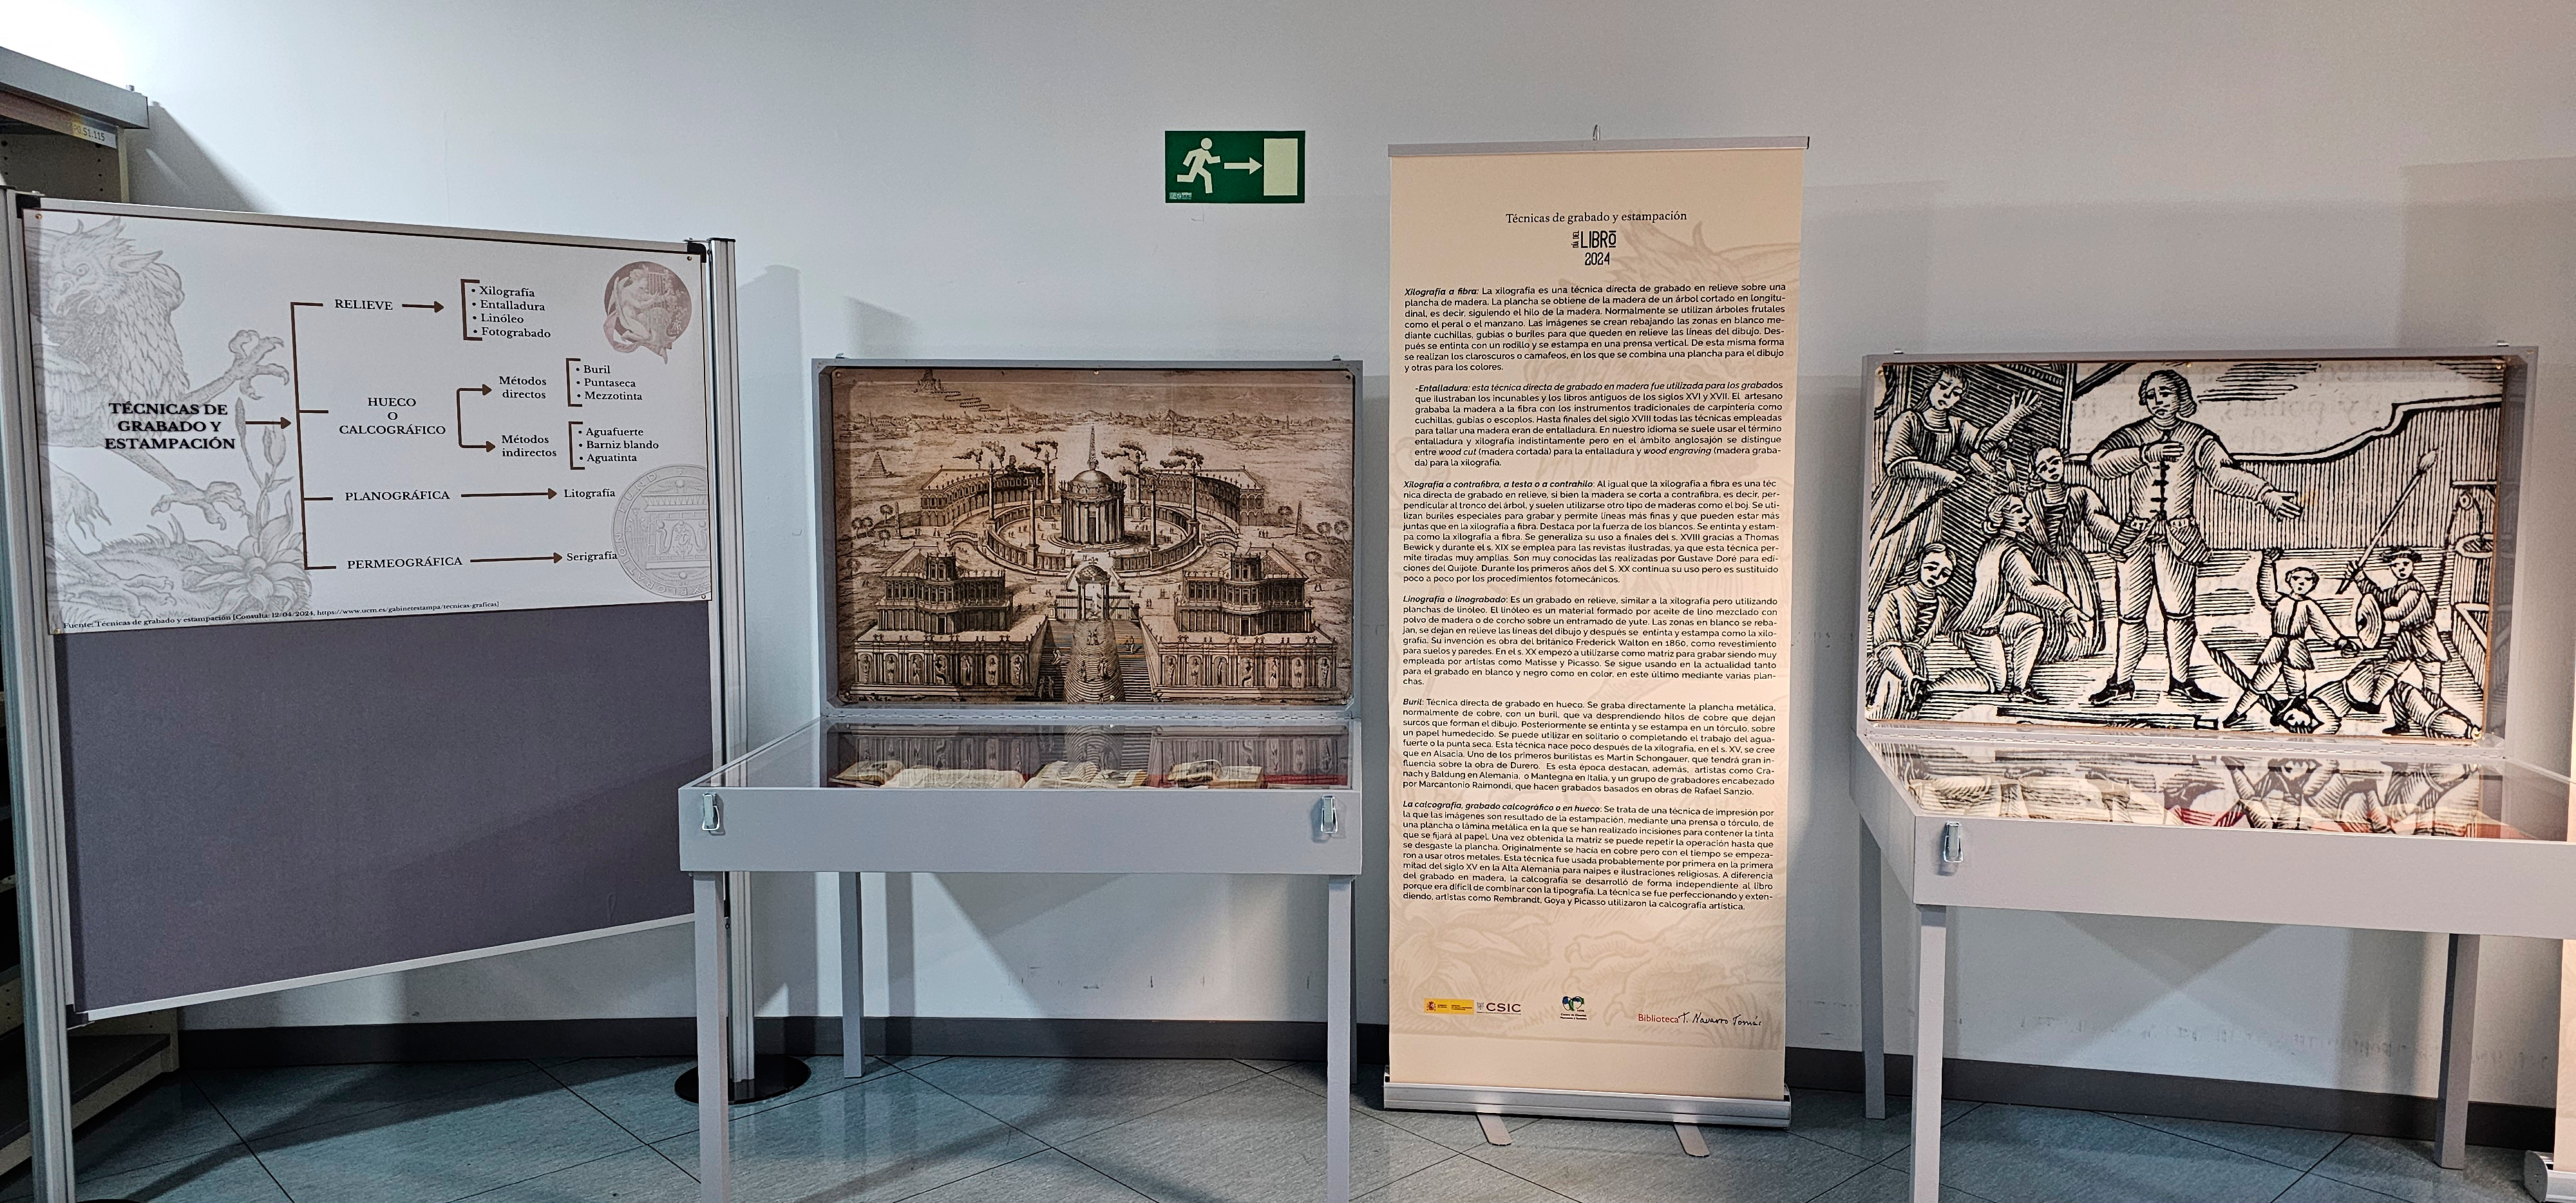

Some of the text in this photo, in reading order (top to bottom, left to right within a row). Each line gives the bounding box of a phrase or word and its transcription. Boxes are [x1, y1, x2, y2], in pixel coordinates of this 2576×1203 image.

[1506, 211, 1687, 225] Técnicas de grabado y estampación
[1585, 252, 1610, 265] 2024
[479, 286, 535, 298] Xilografía
[1405, 288, 1446, 297] Xilografía
[1495, 287, 1535, 296] xilografía
[1654, 284, 1691, 294] grabado
[335, 299, 393, 310] RELIEVE
[480, 299, 545, 311] Entalladura
[481, 313, 524, 323] Linóleo
[482, 327, 551, 340] Fotograbado
[583, 365, 611, 374] Buril
[499, 376, 546, 385] Métodos
[584, 378, 636, 387] Puntaseca
[1566, 383, 1602, 392] grabado
[1651, 383, 1665, 392] fue
[1741, 381, 1783, 390] grabados
[502, 390, 545, 399] directos
[585, 391, 642, 400] Mezzotinta
[368, 397, 416, 406] HUECO
[109, 401, 227, 415] TÉCNICAS DE
[118, 421, 222, 432] GRABADO Y
[339, 424, 446, 434] CALCOGRÁFICO
[586, 428, 643, 438] Aguafuerte
[105, 437, 235, 450] ESTAMPACIÓN
[502, 435, 549, 443] Métodos
[623, 440, 659, 449] blando
[502, 448, 556, 457] indirectos
[587, 453, 637, 464] Aguatinta
[1403, 480, 1444, 489] Xilografía
[1608, 480, 1629, 489] igual
[1660, 480, 1700, 489] xilografía
[345, 489, 450, 500] PLANOGRÁFICA
[564, 489, 615, 499] Litografía
[618, 473, 658, 513] FUND
[567, 551, 618, 562] Serigrafía
[348, 556, 463, 569] PERMEOGRÁFICA
[1403, 595, 1444, 604] Linografía
[1455, 596, 1508, 604] linograbado:
[1536, 596, 1571, 605] grabado
[1670, 597, 1710, 606] xilografía
[1505, 700, 1540, 708] grabado
[1601, 702, 1625, 710] graba
[1700, 703, 1734, 712] plancha
[1415, 801, 1463, 810] calcografía,
[1502, 803, 1553, 812] calcográfico
[1716, 808, 1757, 817] impresión
[1403, 892, 1433, 900] diendo,
[1494, 895, 1542, 904] Rembrandt,
[1544, 897, 1565, 905] Goya
[1659, 901, 1707, 910] calcografía
[1486, 1002, 1521, 1012] CSIC
[1638, 1014, 1678, 1023] Biblioteca
[1692, 1012, 1728, 1024] Navarro
[1732, 1014, 1762, 1026] Tomás
